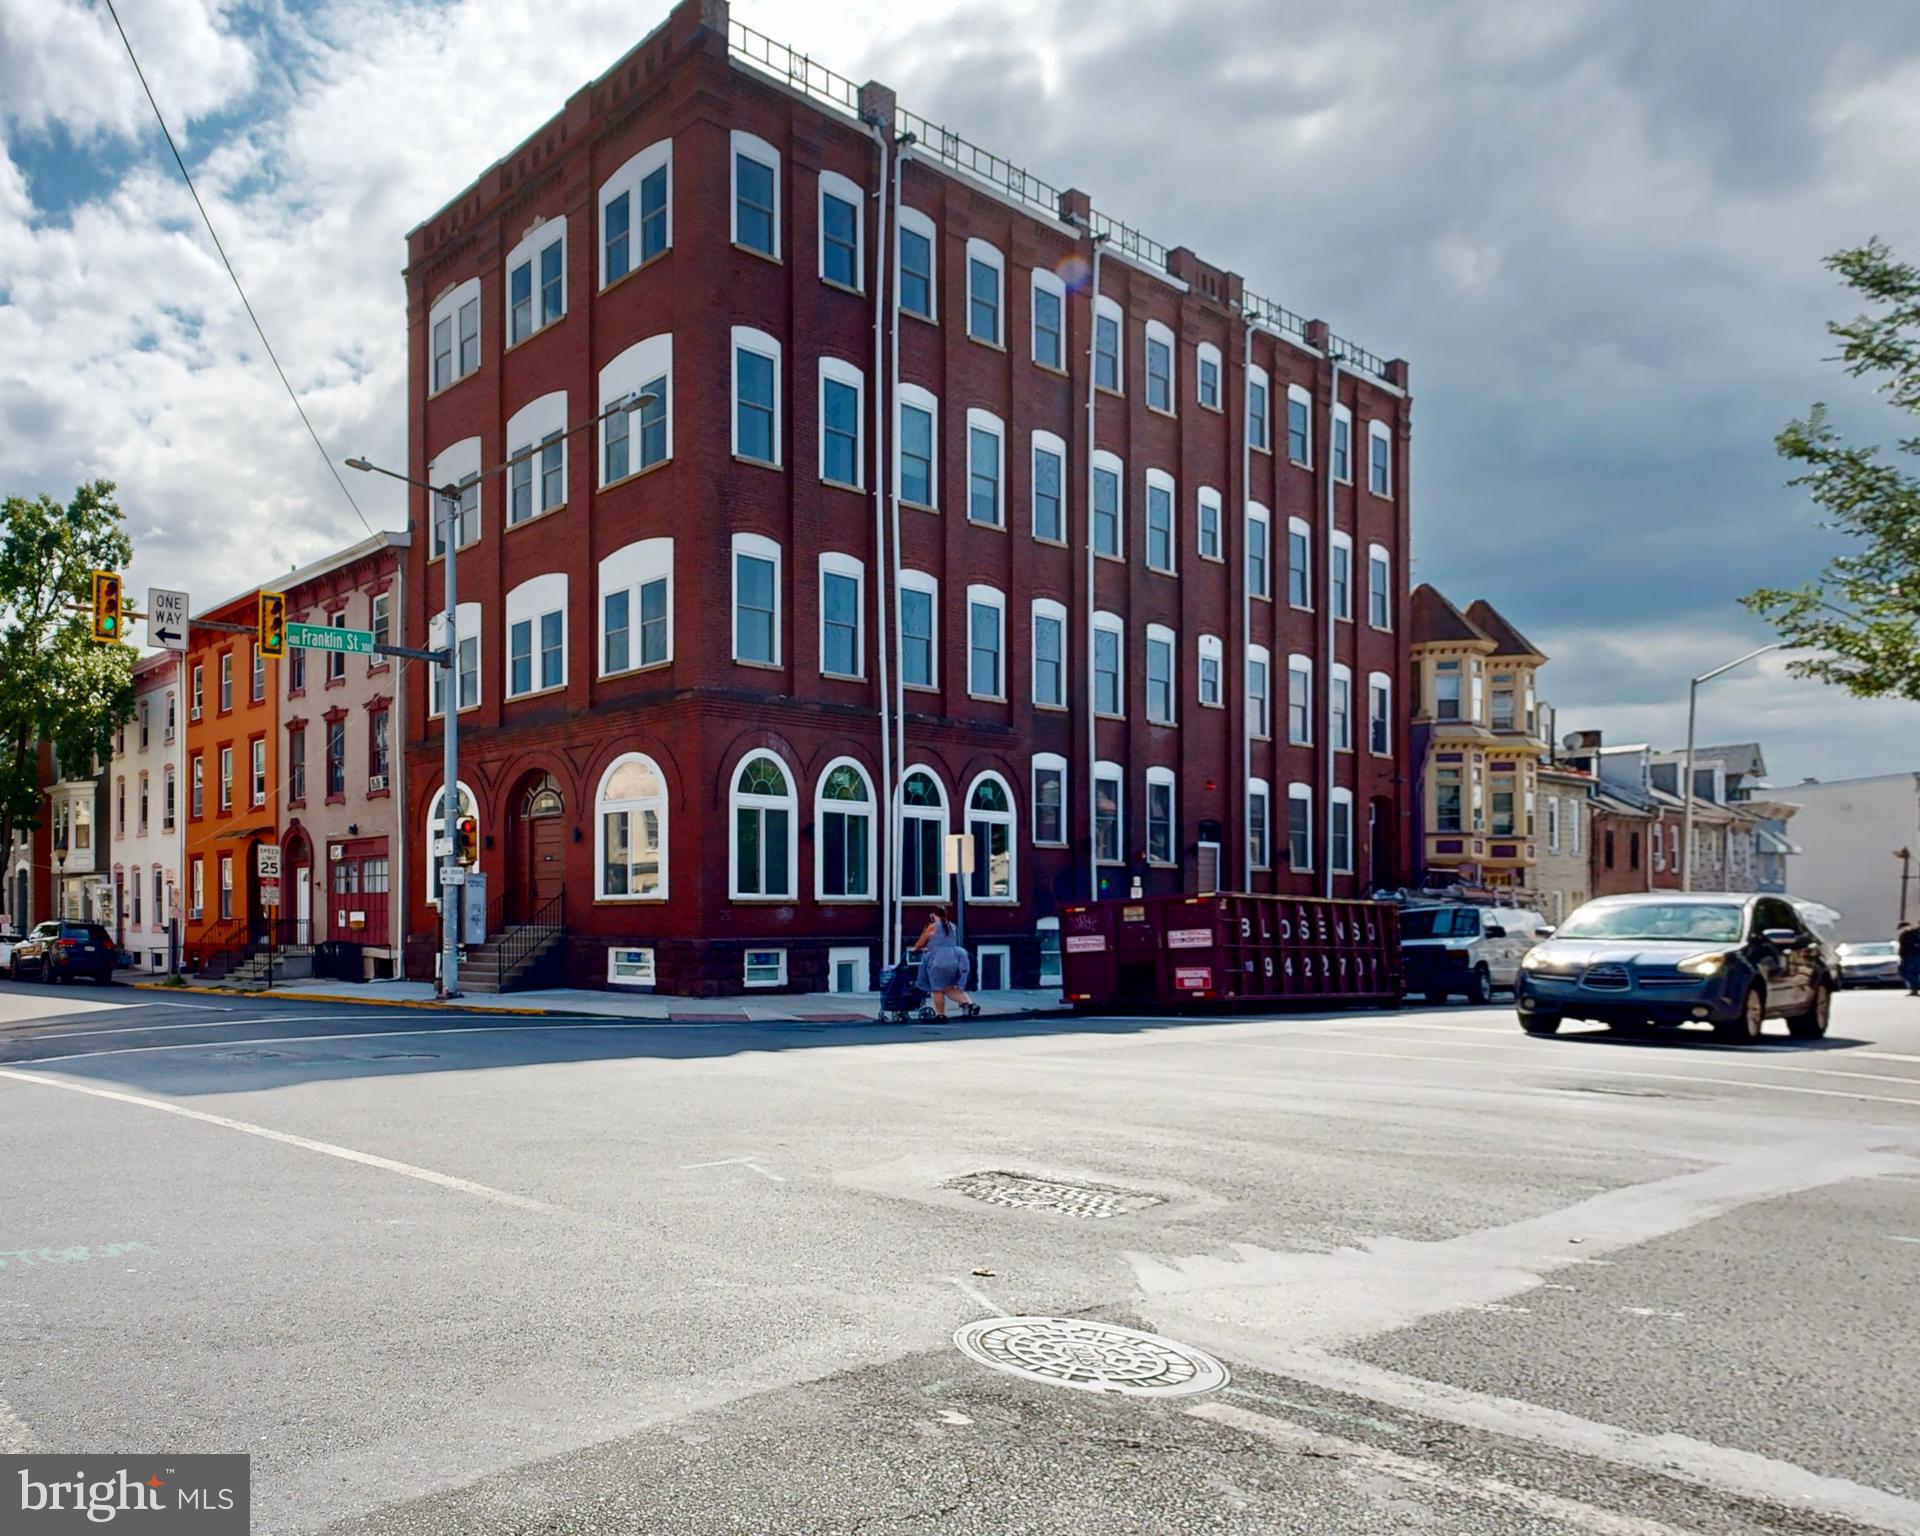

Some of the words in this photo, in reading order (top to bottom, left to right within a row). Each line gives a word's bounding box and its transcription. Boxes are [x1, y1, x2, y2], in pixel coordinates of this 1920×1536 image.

[156, 595, 182, 610] ONE
[156, 610, 182, 625] WAY
[301, 628, 343, 649] Franklin
[346, 633, 359, 651] St
[260, 847, 280, 855] SPEED
[260, 861, 278, 875] 25
